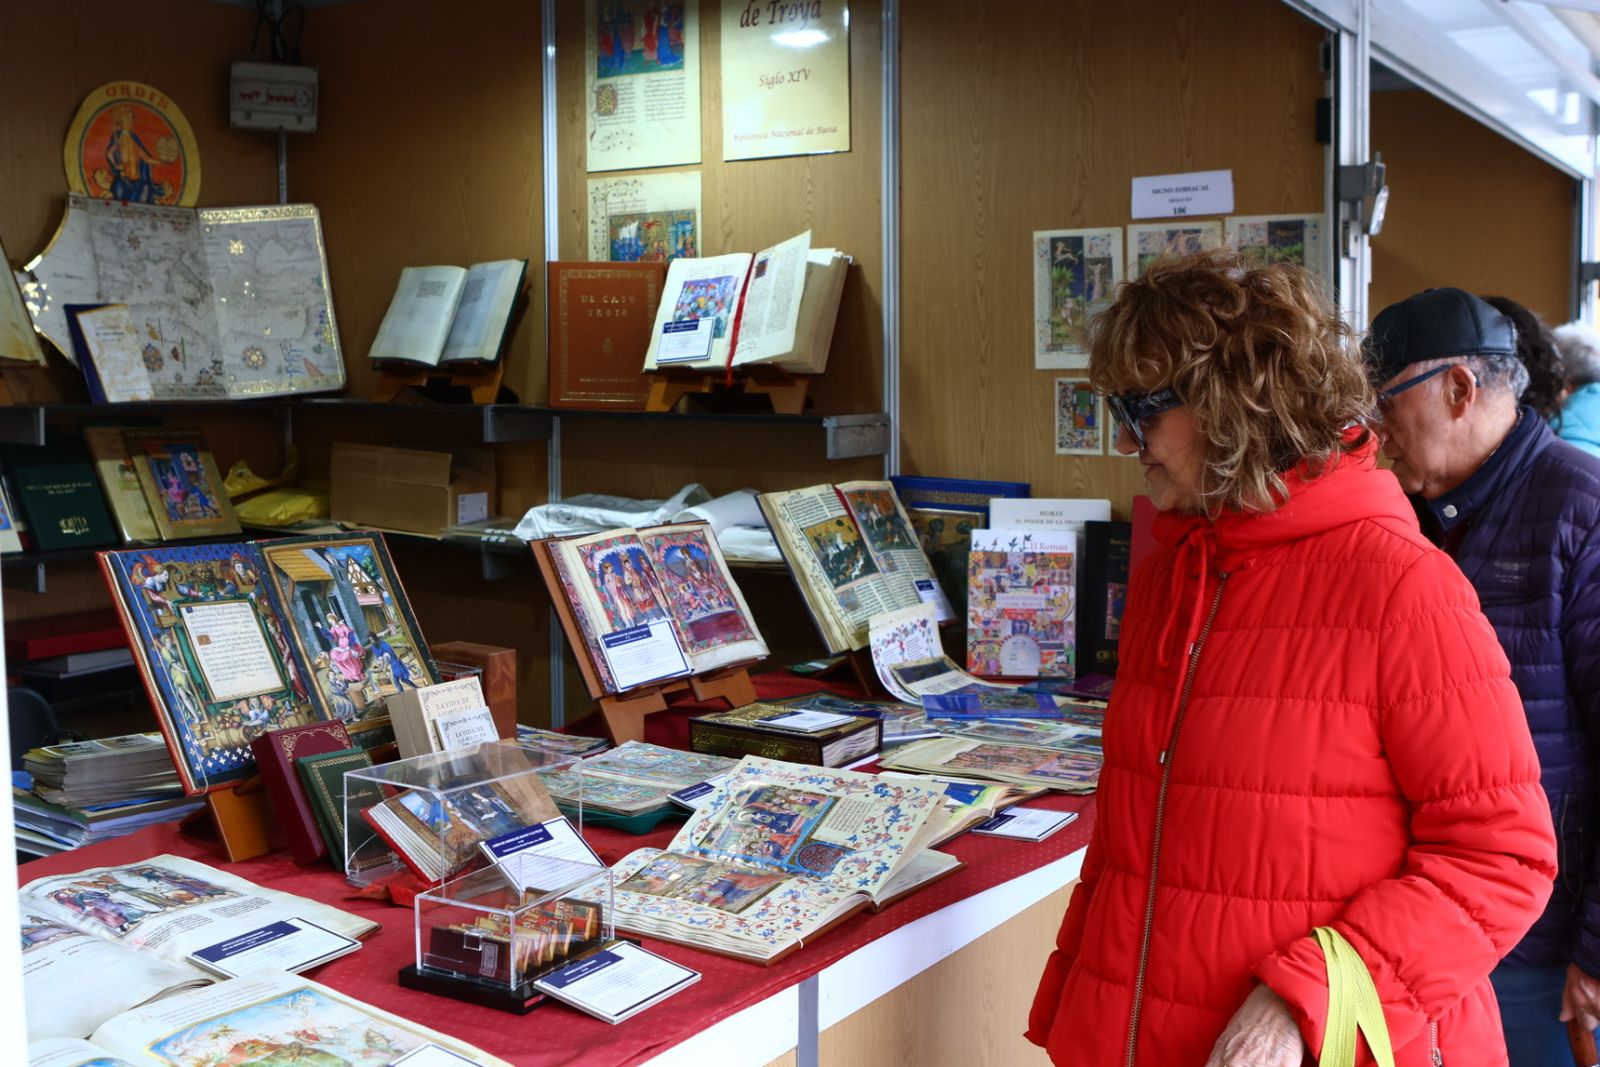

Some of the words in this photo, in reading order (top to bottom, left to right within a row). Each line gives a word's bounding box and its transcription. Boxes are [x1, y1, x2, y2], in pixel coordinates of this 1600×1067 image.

[740, 0, 760, 28] de
[766, 0, 821, 30] Troya
[759, 71, 785, 89] Siglo
[787, 68, 811, 83] XIV
[1039, 543, 1068, 551] Roman
